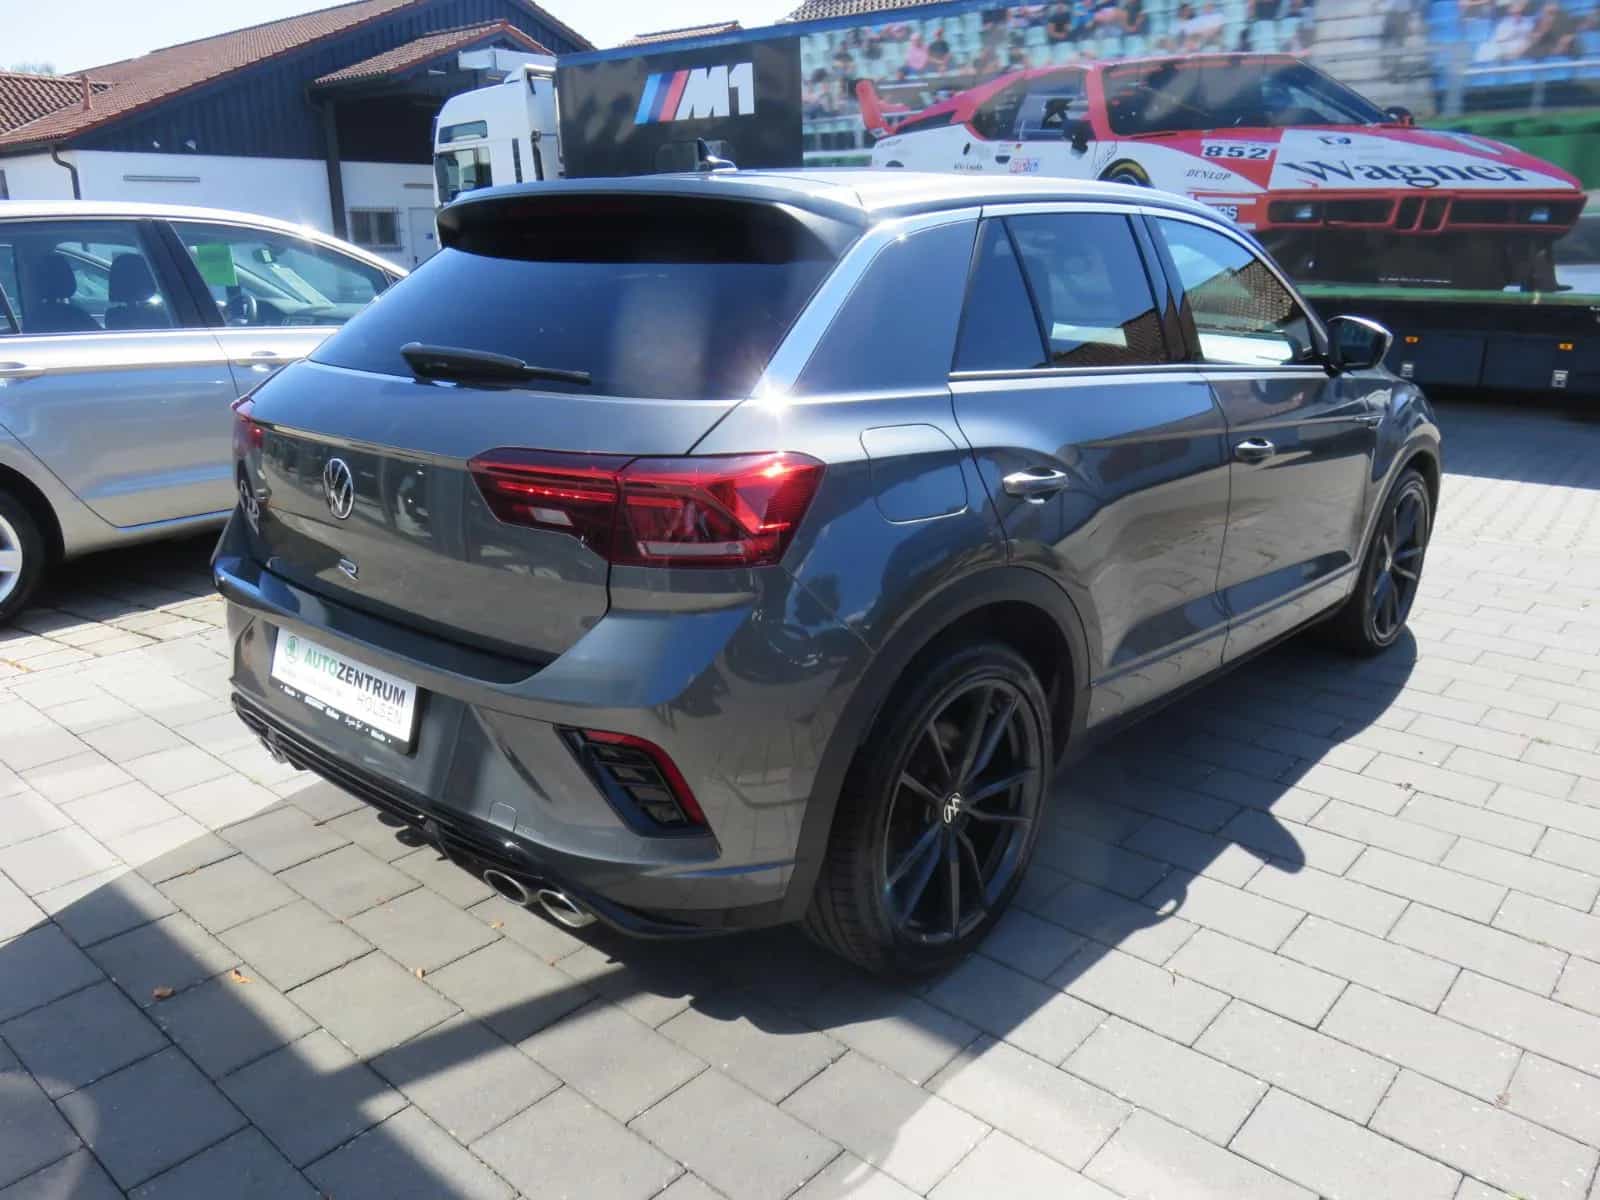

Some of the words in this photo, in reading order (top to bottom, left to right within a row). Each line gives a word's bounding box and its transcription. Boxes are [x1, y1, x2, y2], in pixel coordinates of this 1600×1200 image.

[675, 62, 755, 121] M1
[1205, 145, 1268, 160] 852
[1186, 168, 1232, 181] DUNLOP
[1281, 160, 1529, 189] Wagner
[303, 647, 406, 708] AUTOZENTRUM
